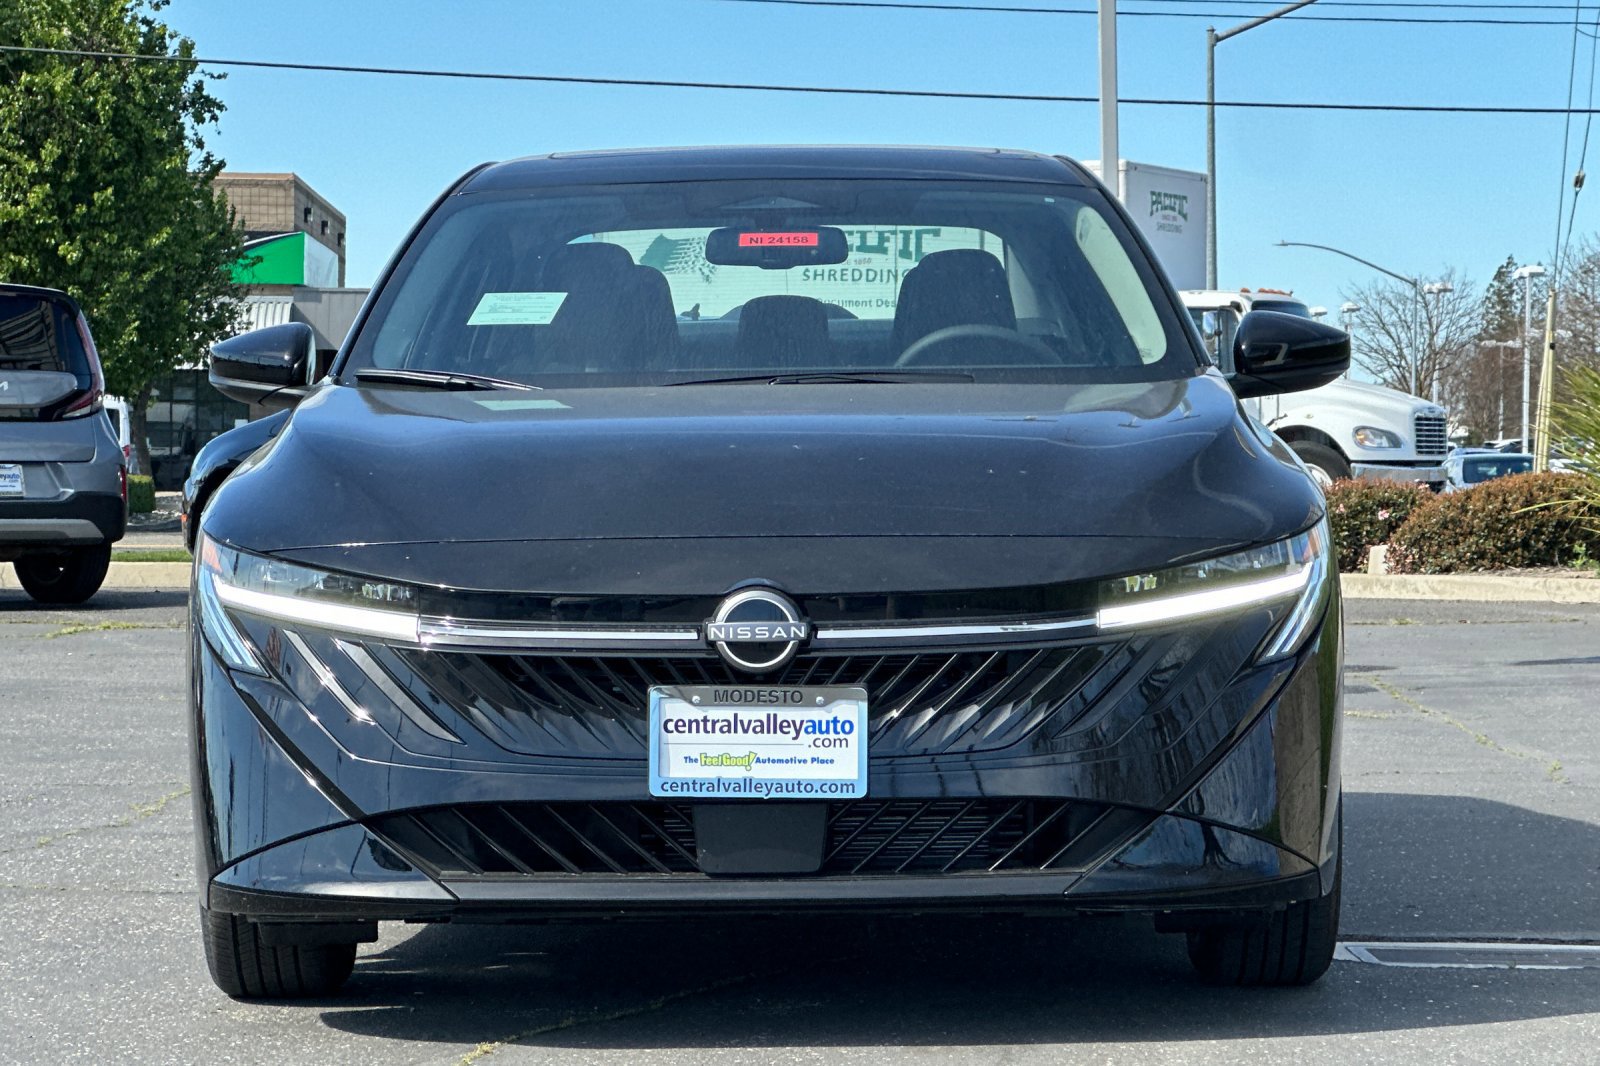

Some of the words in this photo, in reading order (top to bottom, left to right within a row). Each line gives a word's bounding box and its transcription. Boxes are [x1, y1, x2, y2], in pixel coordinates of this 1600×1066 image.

[1150, 190, 1188, 222] PACIFIC
[749, 236, 763, 244] NI
[767, 236, 809, 244] 24158
[710, 626, 805, 639] NISSAN
[713, 689, 803, 704] MODESTO
[662, 712, 855, 741] centralvalleyauto
[807, 736, 849, 749] .com
[683, 756, 699, 764] The
[755, 756, 808, 764] Automotive
[811, 756, 835, 764] Place
[660, 778, 856, 798] centralvalleyauto.com
